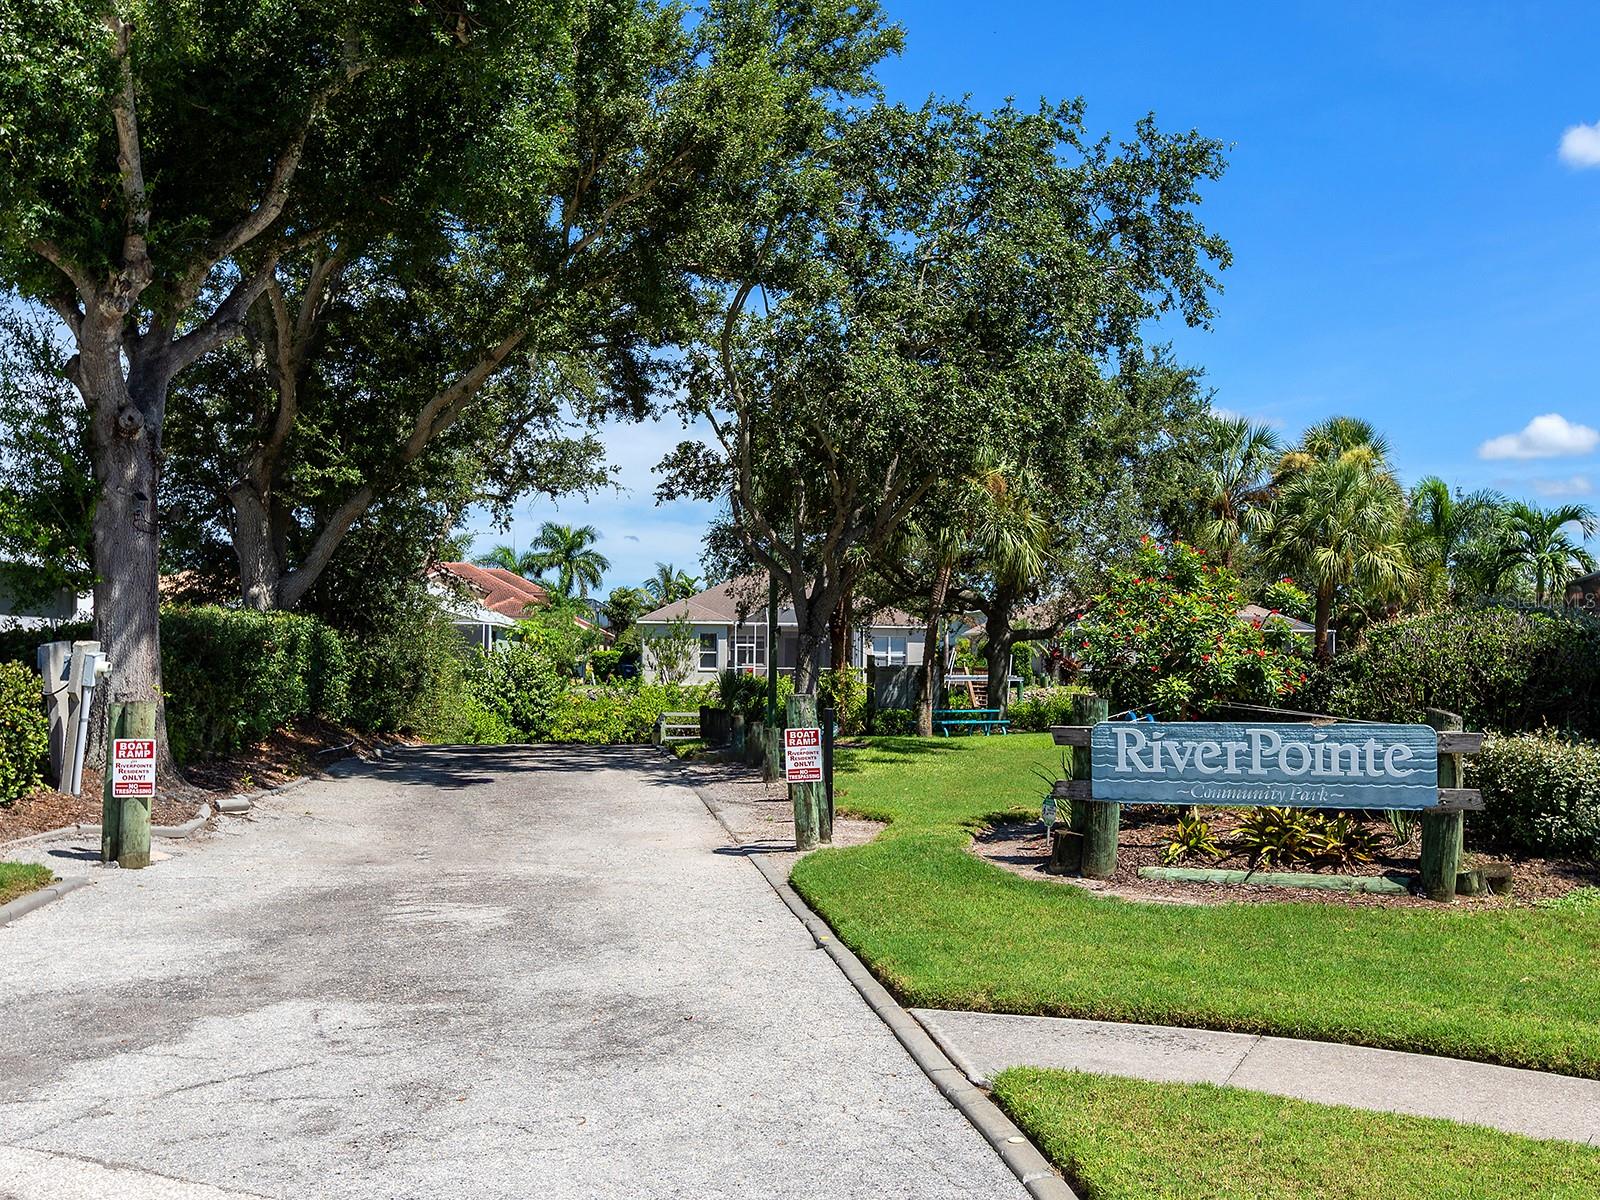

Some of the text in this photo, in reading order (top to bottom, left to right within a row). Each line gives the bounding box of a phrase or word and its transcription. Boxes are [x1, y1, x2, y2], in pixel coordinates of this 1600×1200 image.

[1112, 728, 1414, 778] RiverPointe
[1190, 785, 1329, 803] Community Park
